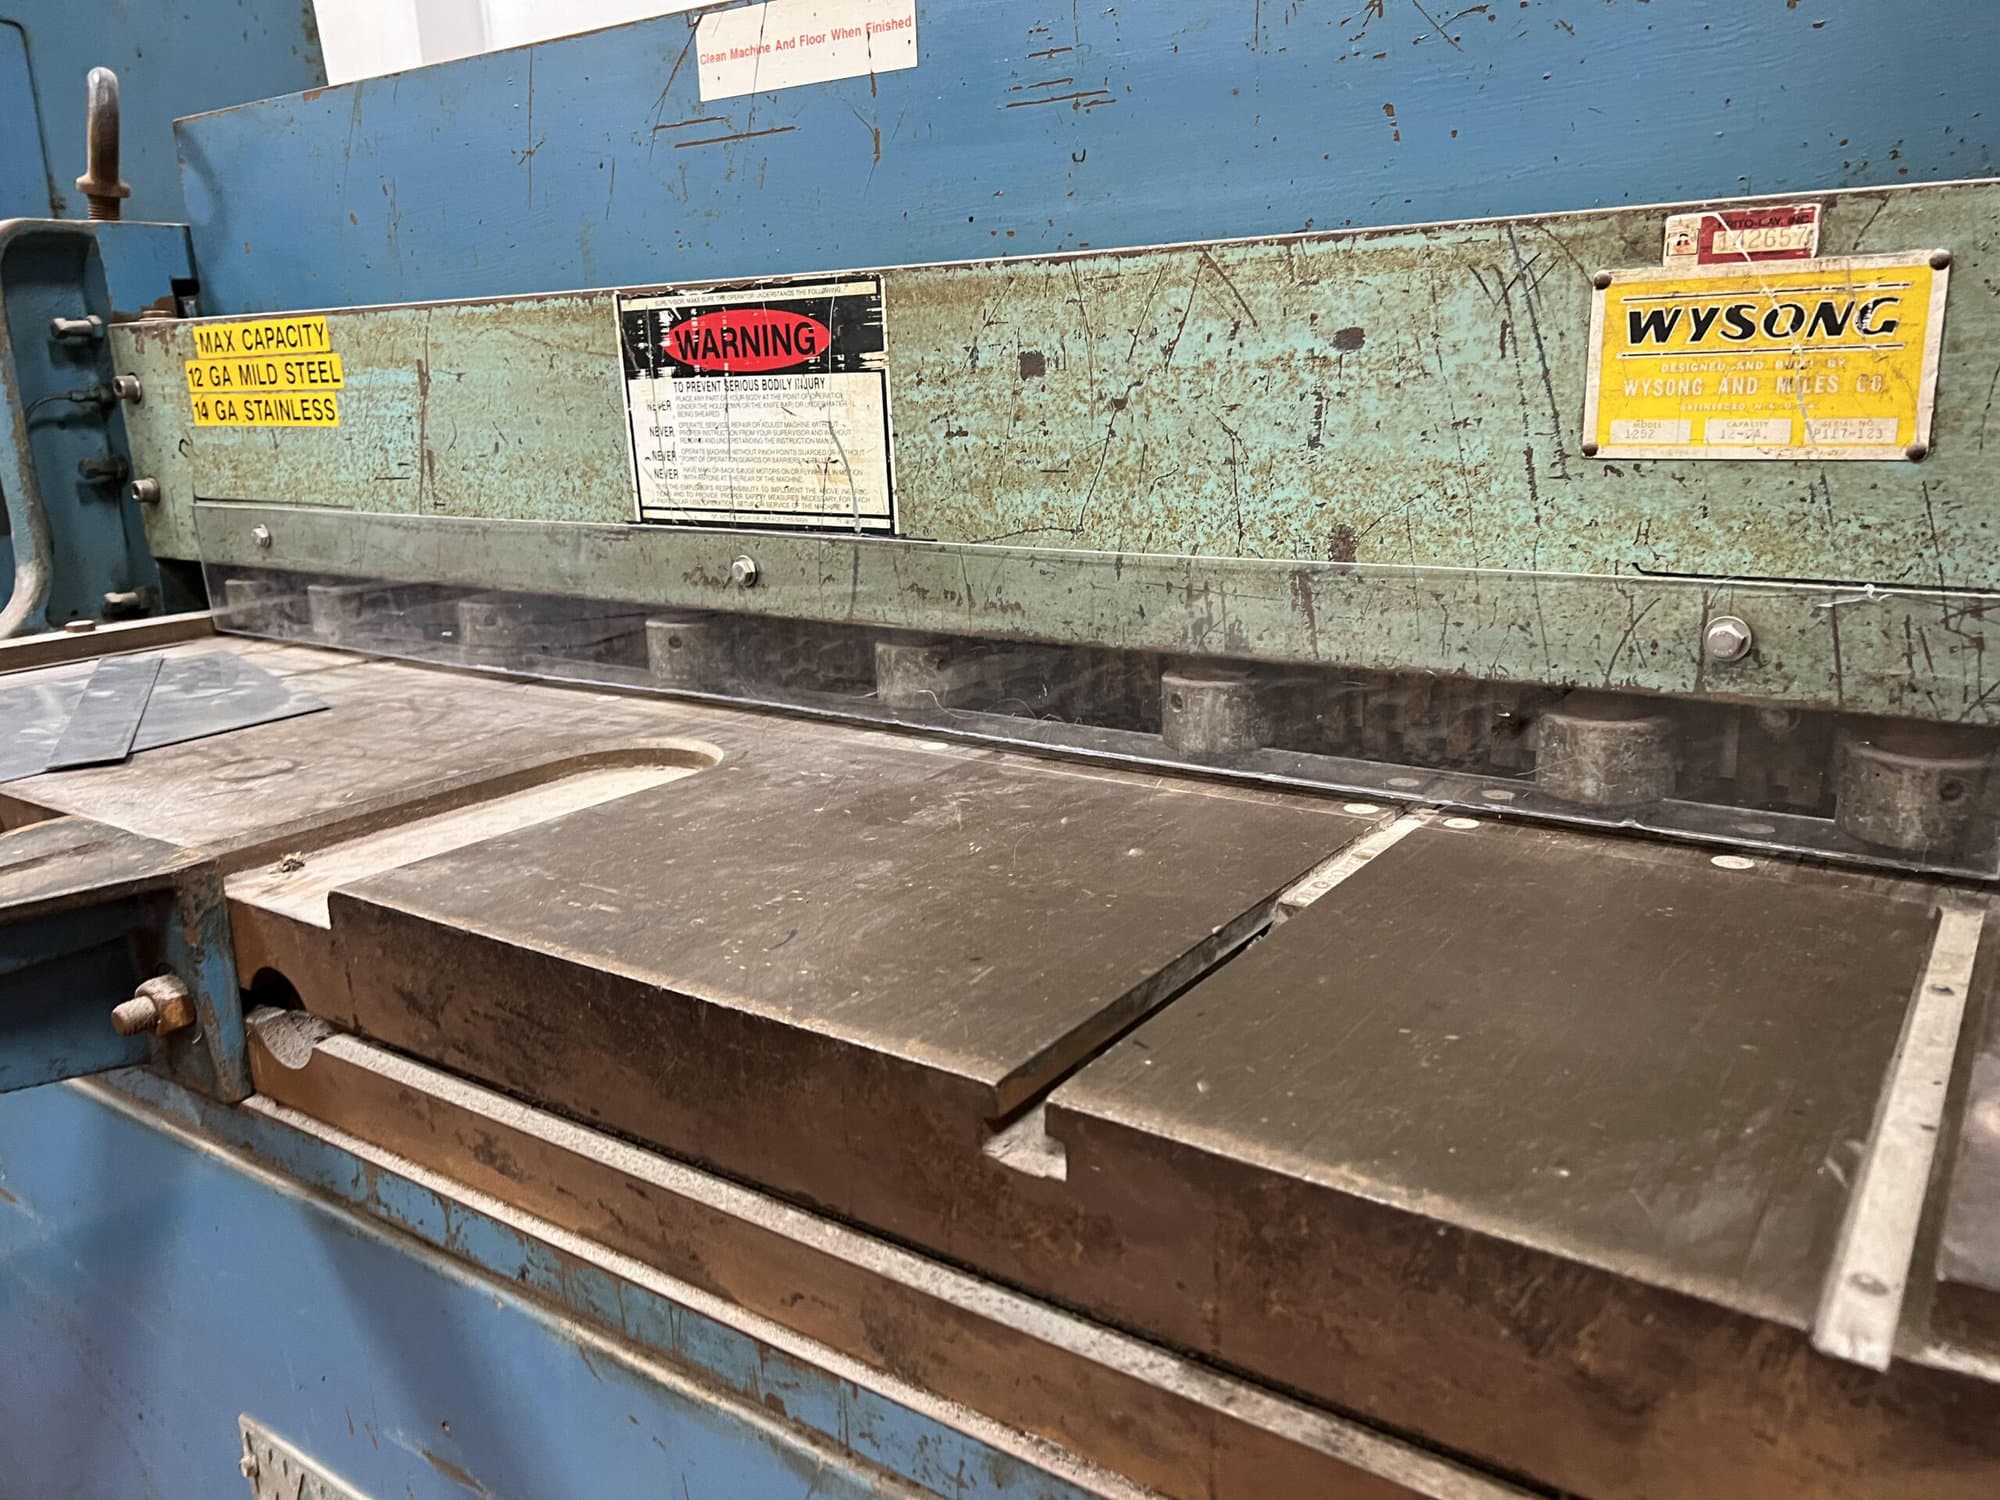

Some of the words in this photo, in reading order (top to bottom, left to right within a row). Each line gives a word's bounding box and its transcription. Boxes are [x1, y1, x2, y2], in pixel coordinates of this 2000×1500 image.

[700, 51, 727, 65] Clean
[730, 45, 771, 60] Machine
[775, 35, 796, 51] And
[799, 34, 827, 48] Floor
[831, 27, 861, 41] When
[866, 16, 912, 34] Finished
[1627, 297, 1899, 345] WYSONG
[199, 330, 235, 353] MAX
[242, 322, 324, 351] CAPACITY
[675, 321, 816, 361] WARNING
[188, 367, 204, 387] 12
[210, 365, 233, 387] GA
[239, 363, 278, 386] MILD
[285, 360, 341, 384] STEEL
[673, 381, 684, 393] TO
[686, 380, 721, 393] PREVENT
[724, 378, 760, 392] SERIOUS
[762, 378, 792, 391] BODILY
[1623, 376, 1704, 398] WYSONG
[1719, 374, 1759, 396] AND
[194, 401, 209, 421] 14
[215, 400, 239, 421] GA
[244, 398, 336, 422] STAINLESS
[649, 425, 675, 438] NEVER
[652, 449, 677, 462] NEVER
[654, 468, 679, 480] NEVER
